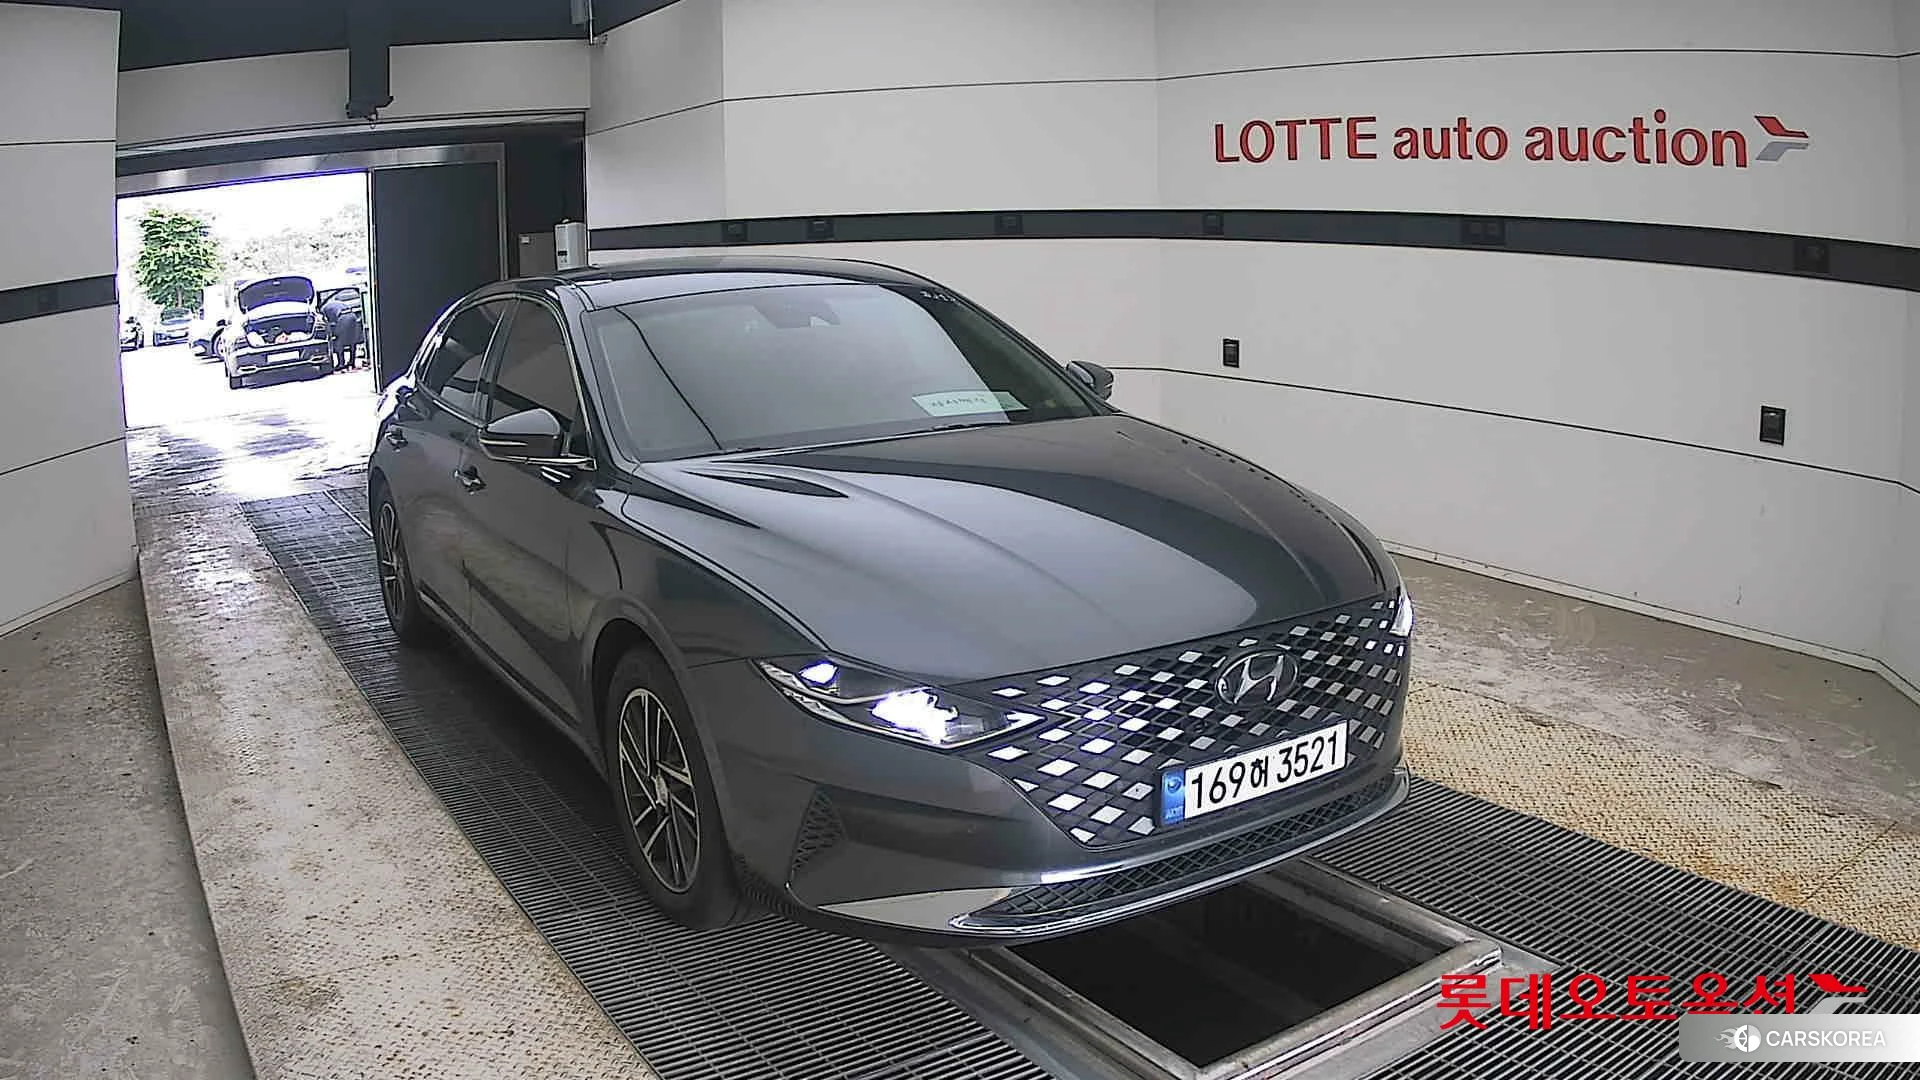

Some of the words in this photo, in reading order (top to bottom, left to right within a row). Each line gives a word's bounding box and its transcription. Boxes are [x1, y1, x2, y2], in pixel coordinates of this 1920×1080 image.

[1214, 115, 1378, 164] LOTTE
[1392, 116, 1509, 162] auto
[1524, 109, 1749, 168] auction
[1191, 755, 1269, 808] 169허
[1276, 731, 1338, 783] 3521
